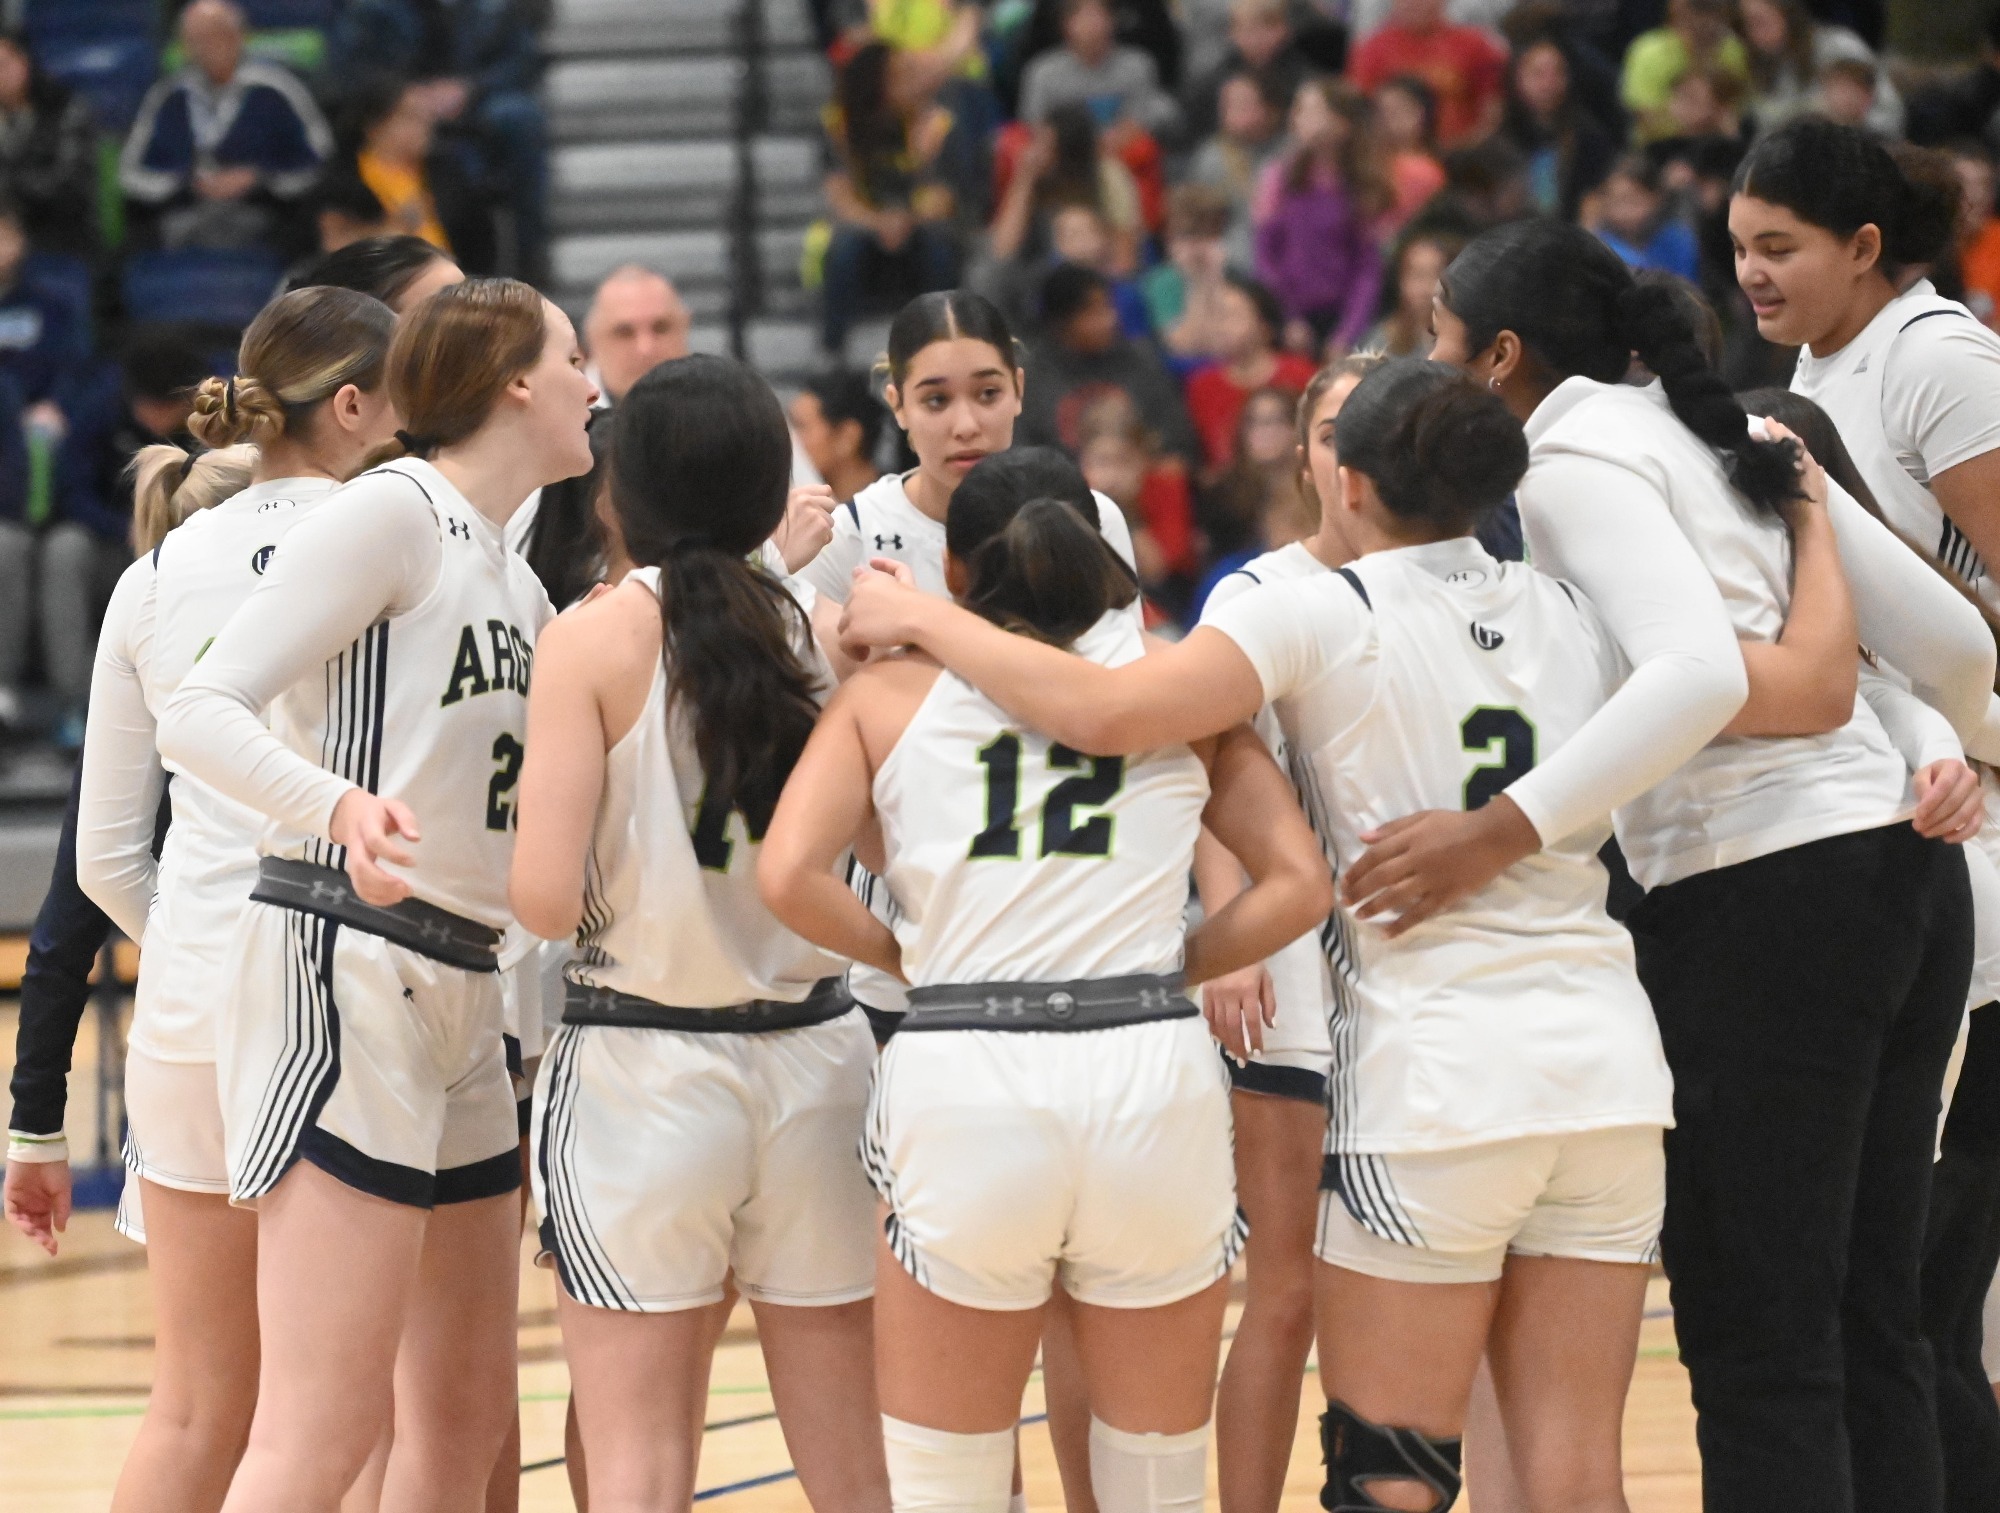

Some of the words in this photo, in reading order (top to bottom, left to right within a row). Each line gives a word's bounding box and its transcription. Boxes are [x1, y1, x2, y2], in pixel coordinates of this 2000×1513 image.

[440, 619, 533, 708] ARG
[485, 732, 524, 832] 2
[966, 729, 1126, 861] 12
[1459, 704, 1538, 811] 2
